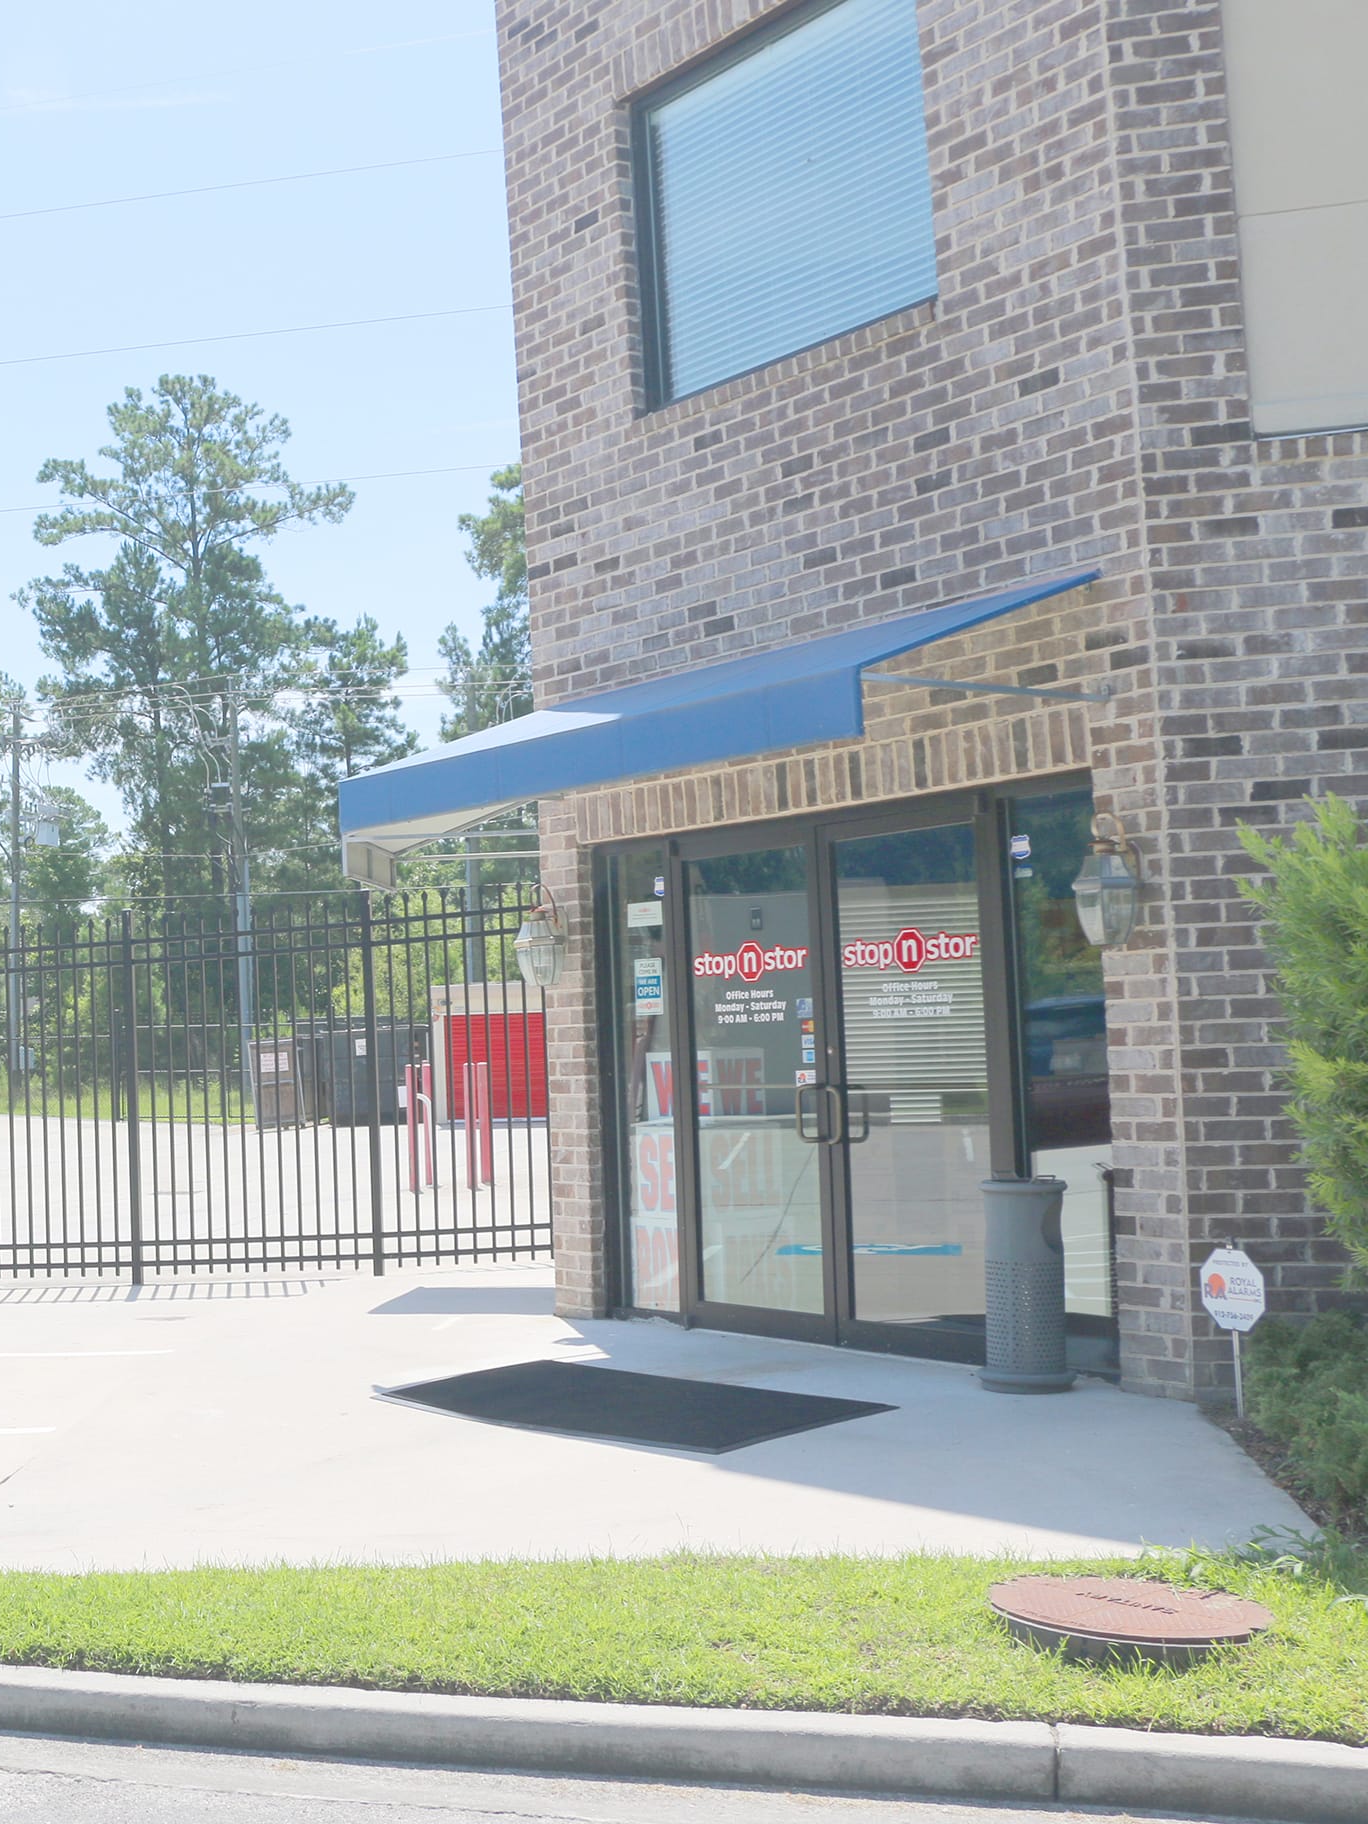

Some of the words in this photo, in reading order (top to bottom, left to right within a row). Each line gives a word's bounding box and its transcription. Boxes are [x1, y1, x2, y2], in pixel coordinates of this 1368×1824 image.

[844, 940, 893, 969] stop
[926, 933, 976, 960] stor
[694, 952, 736, 979] stop
[764, 946, 807, 971] stor
[637, 986, 660, 997] OPEN
[882, 983, 909, 992] Office
[911, 981, 938, 991] Hours
[725, 991, 749, 1000] Office
[750, 989, 774, 999] Hours
[869, 995, 905, 1006] Monday
[911, 993, 953, 1004] Saturday
[715, 1002, 745, 1013] Monday
[750, 1000, 787, 1011] Saturday
[893, 1007, 907, 1017] AM
[936, 1005, 951, 1015] PM
[735, 1014, 748, 1023] AM
[753, 1013, 770, 1022] 6:00
[772, 1012, 784, 1021] PM
[1229, 1277, 1257, 1288] ROYAL
[1227, 1286, 1262, 1298] ALARMS
